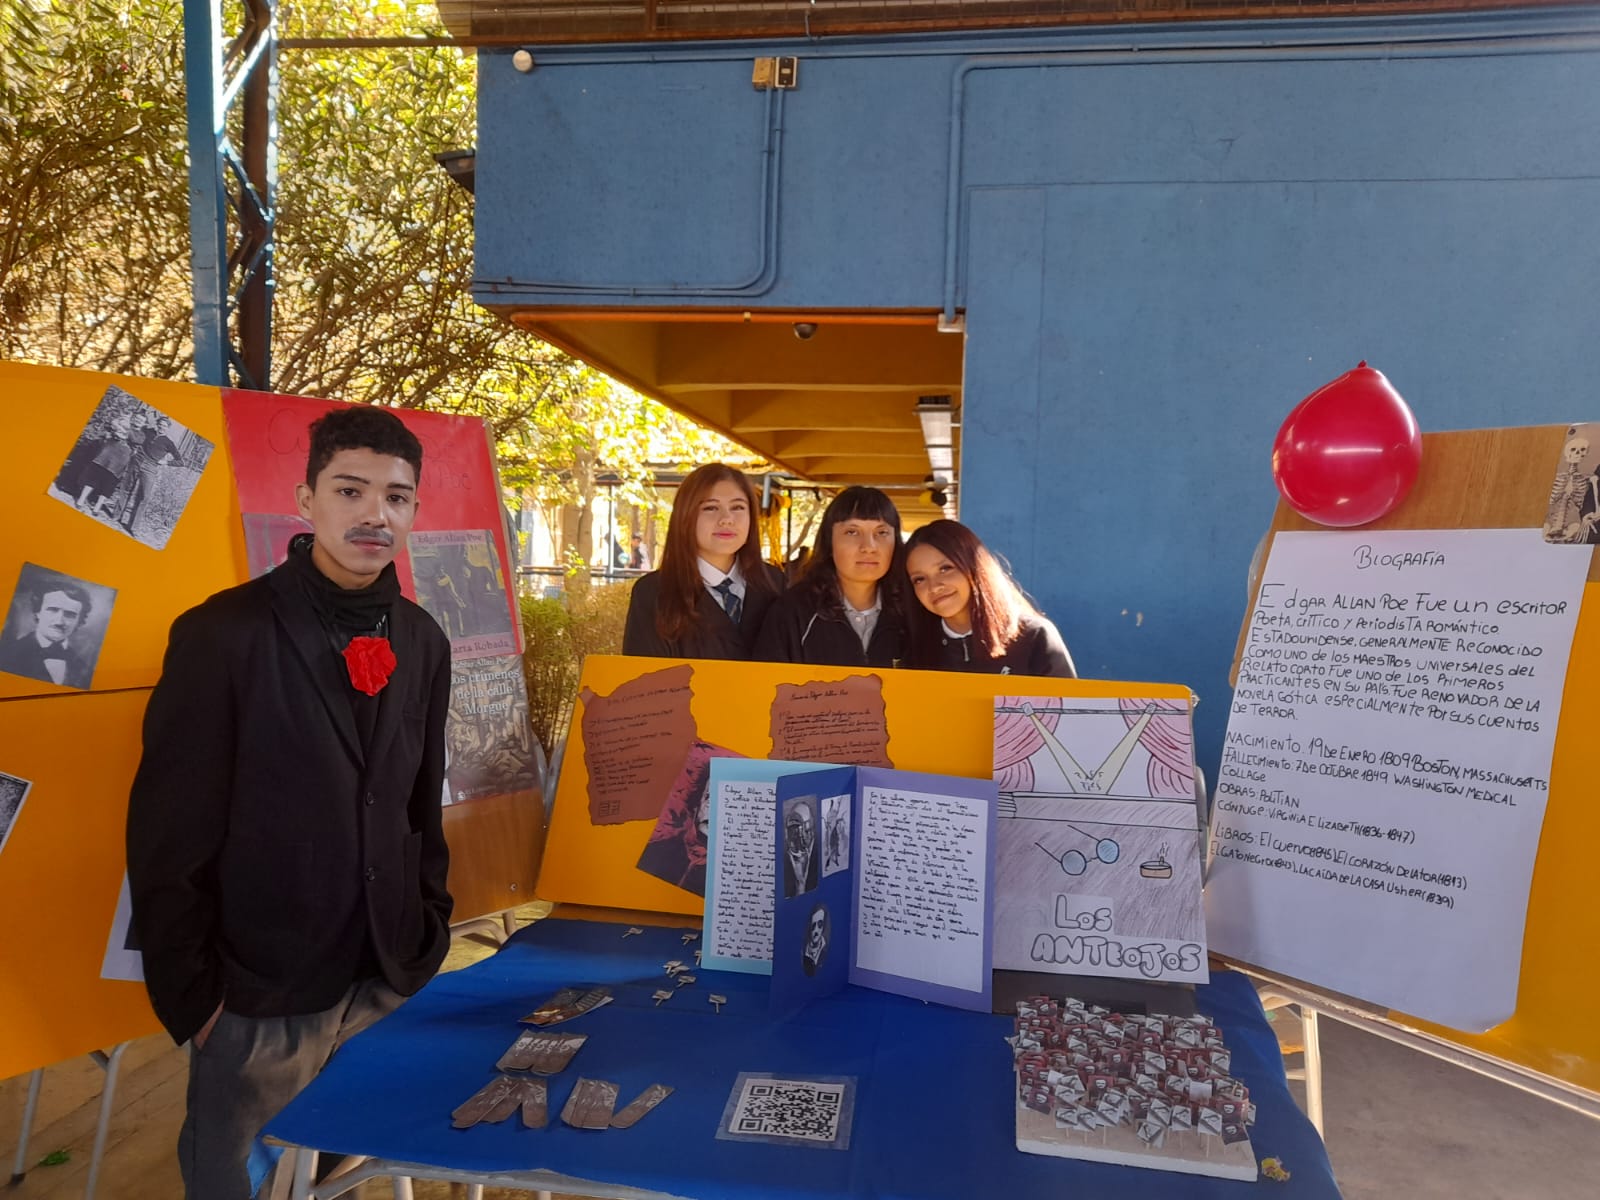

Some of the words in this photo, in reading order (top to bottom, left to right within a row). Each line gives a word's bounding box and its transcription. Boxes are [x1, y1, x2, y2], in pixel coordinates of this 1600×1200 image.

[417, 530, 441, 545] Edgar
[465, 531, 482, 542] Poe
[1379, 593, 1409, 611] Poe
[1416, 592, 1447, 612] Fue
[1453, 599, 1488, 613] un
[452, 645, 473, 655] arta
[474, 637, 511, 652] Robada
[468, 670, 520, 683] crímenes
[456, 686, 472, 701] de
[473, 685, 485, 699] la
[487, 683, 514, 697] calle
[464, 701, 509, 716] Morgue
[1308, 736, 1324, 758] 19
[1378, 751, 1411, 769] 1809
[1360, 768, 1389, 784] 1849
[1055, 894, 1113, 932] Los
[1030, 933, 1202, 979] ANTEOJOS
